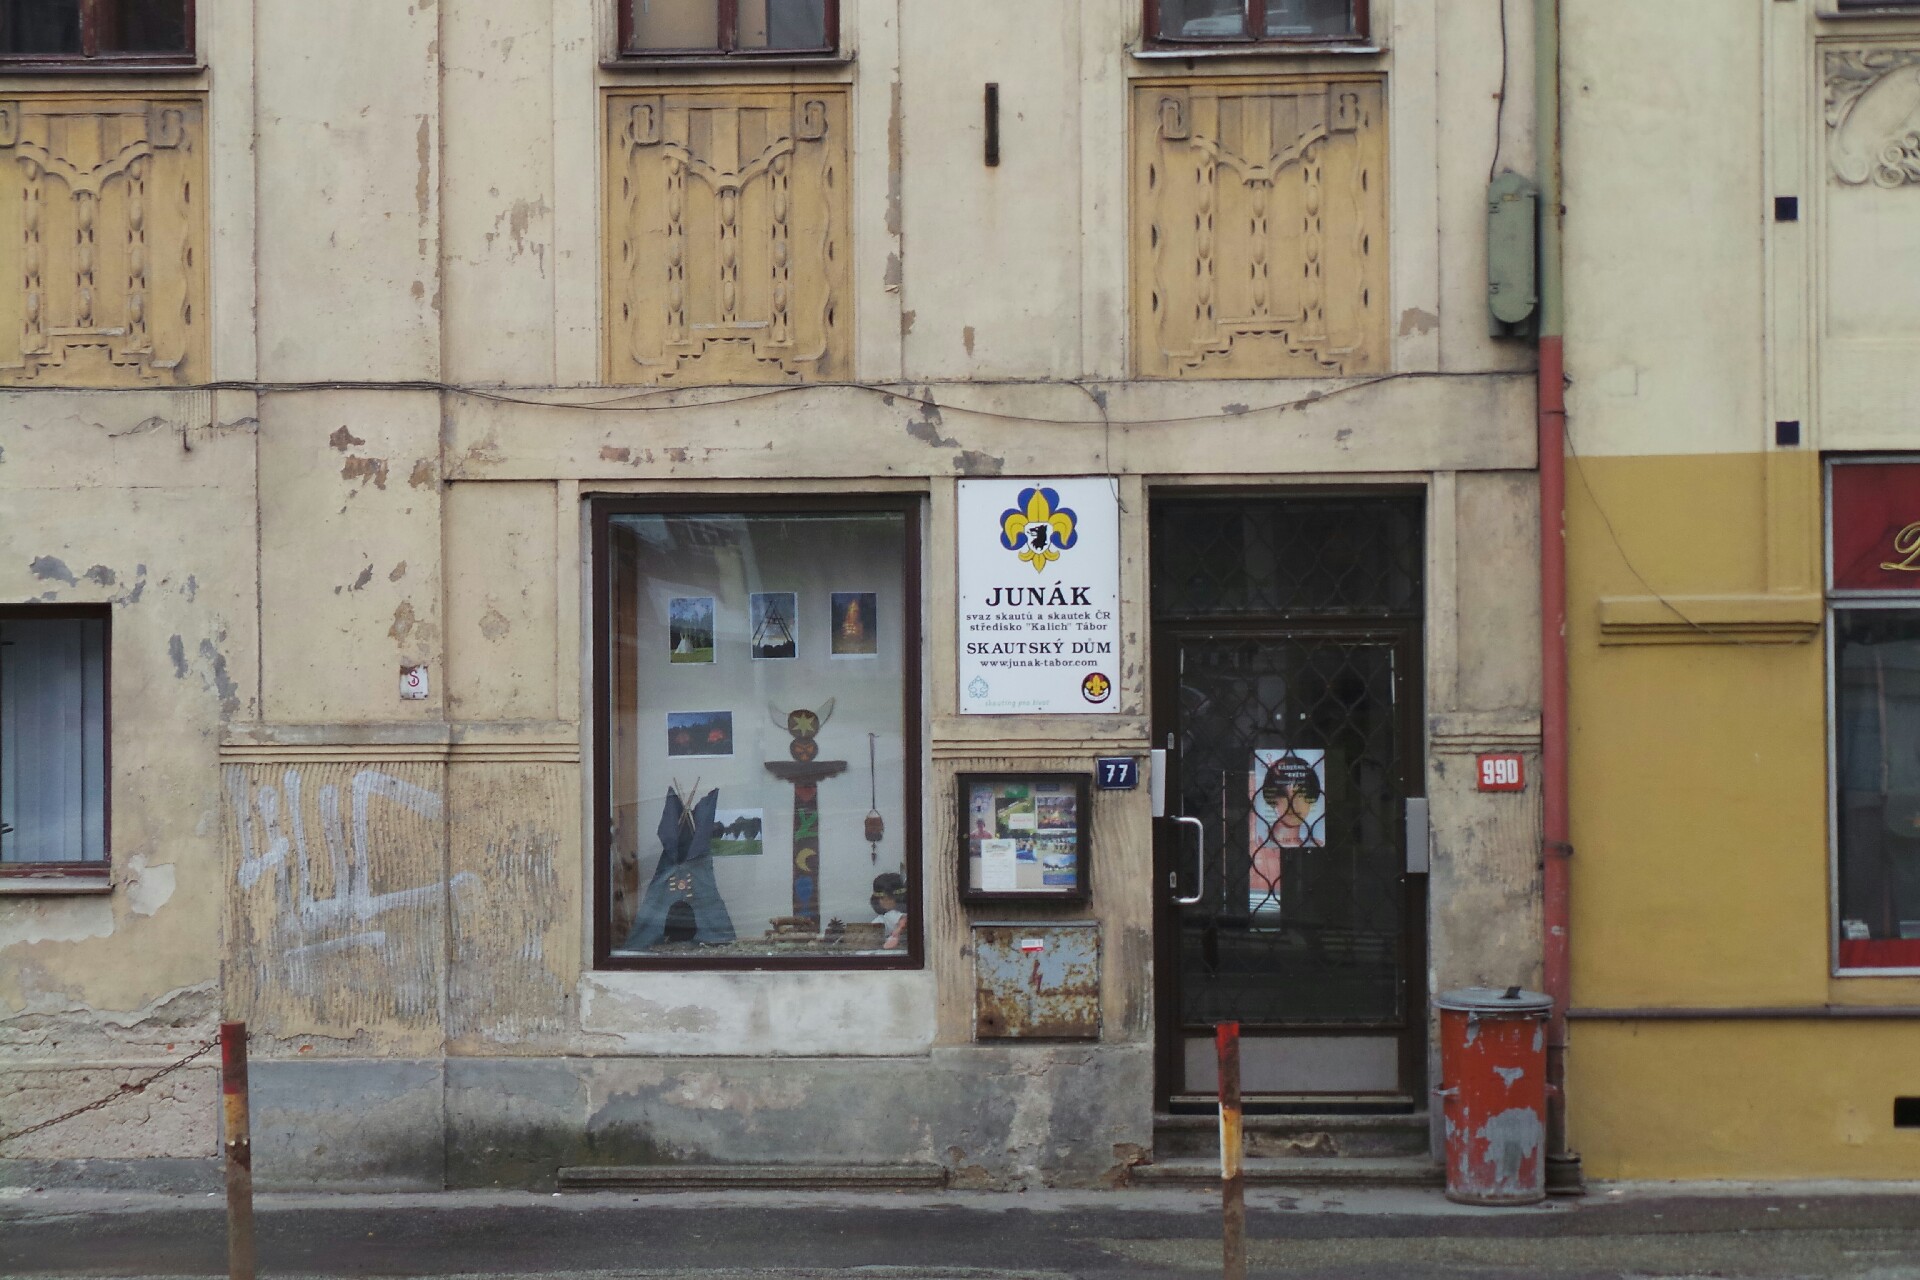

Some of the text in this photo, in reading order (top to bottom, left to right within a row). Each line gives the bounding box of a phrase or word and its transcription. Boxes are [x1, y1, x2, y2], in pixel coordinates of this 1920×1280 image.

[985, 580, 1092, 607] JUNÁK
[1037, 613, 1044, 621] a
[1047, 611, 1091, 621] skautek
[1095, 609, 1111, 620] ČR
[969, 622, 1023, 632] středisko
[1076, 621, 1108, 631] Tábor
[966, 638, 1112, 655] SKAUTSKÝ DŮM
[980, 657, 1098, 669] www.junak-tabor.com
[1106, 764, 1128, 783] 77
[1483, 759, 1519, 784] 990
